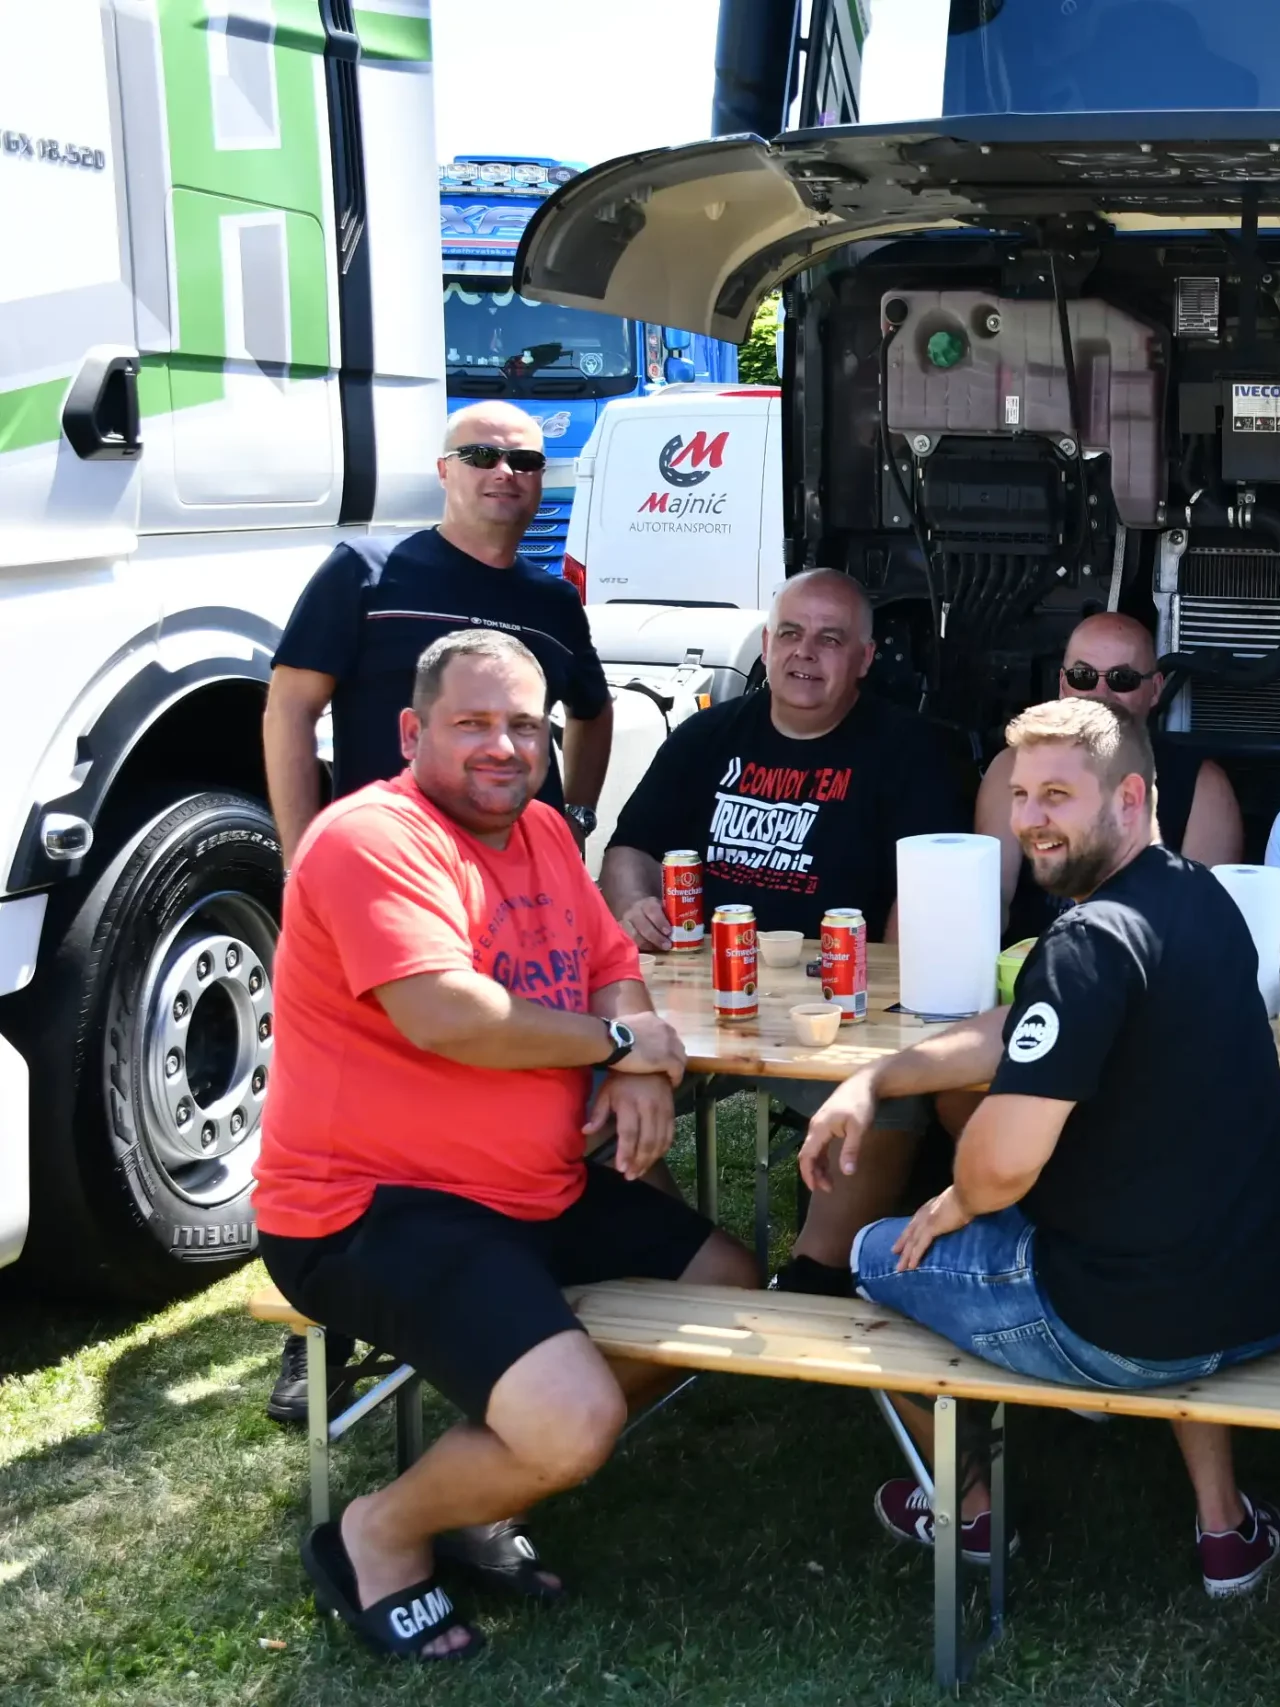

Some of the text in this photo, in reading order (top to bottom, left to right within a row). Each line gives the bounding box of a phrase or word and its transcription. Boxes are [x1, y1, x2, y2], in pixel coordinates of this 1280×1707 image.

[0, 129, 105, 171] GX 18.520
[637, 492, 727, 518] Majnić
[629, 522, 732, 534] AUTOTRANSPORTI
[482, 618, 521, 631] TOM TAILOR
[738, 762, 809, 801] CONVOY
[710, 791, 819, 851] TRUCKSHOW
